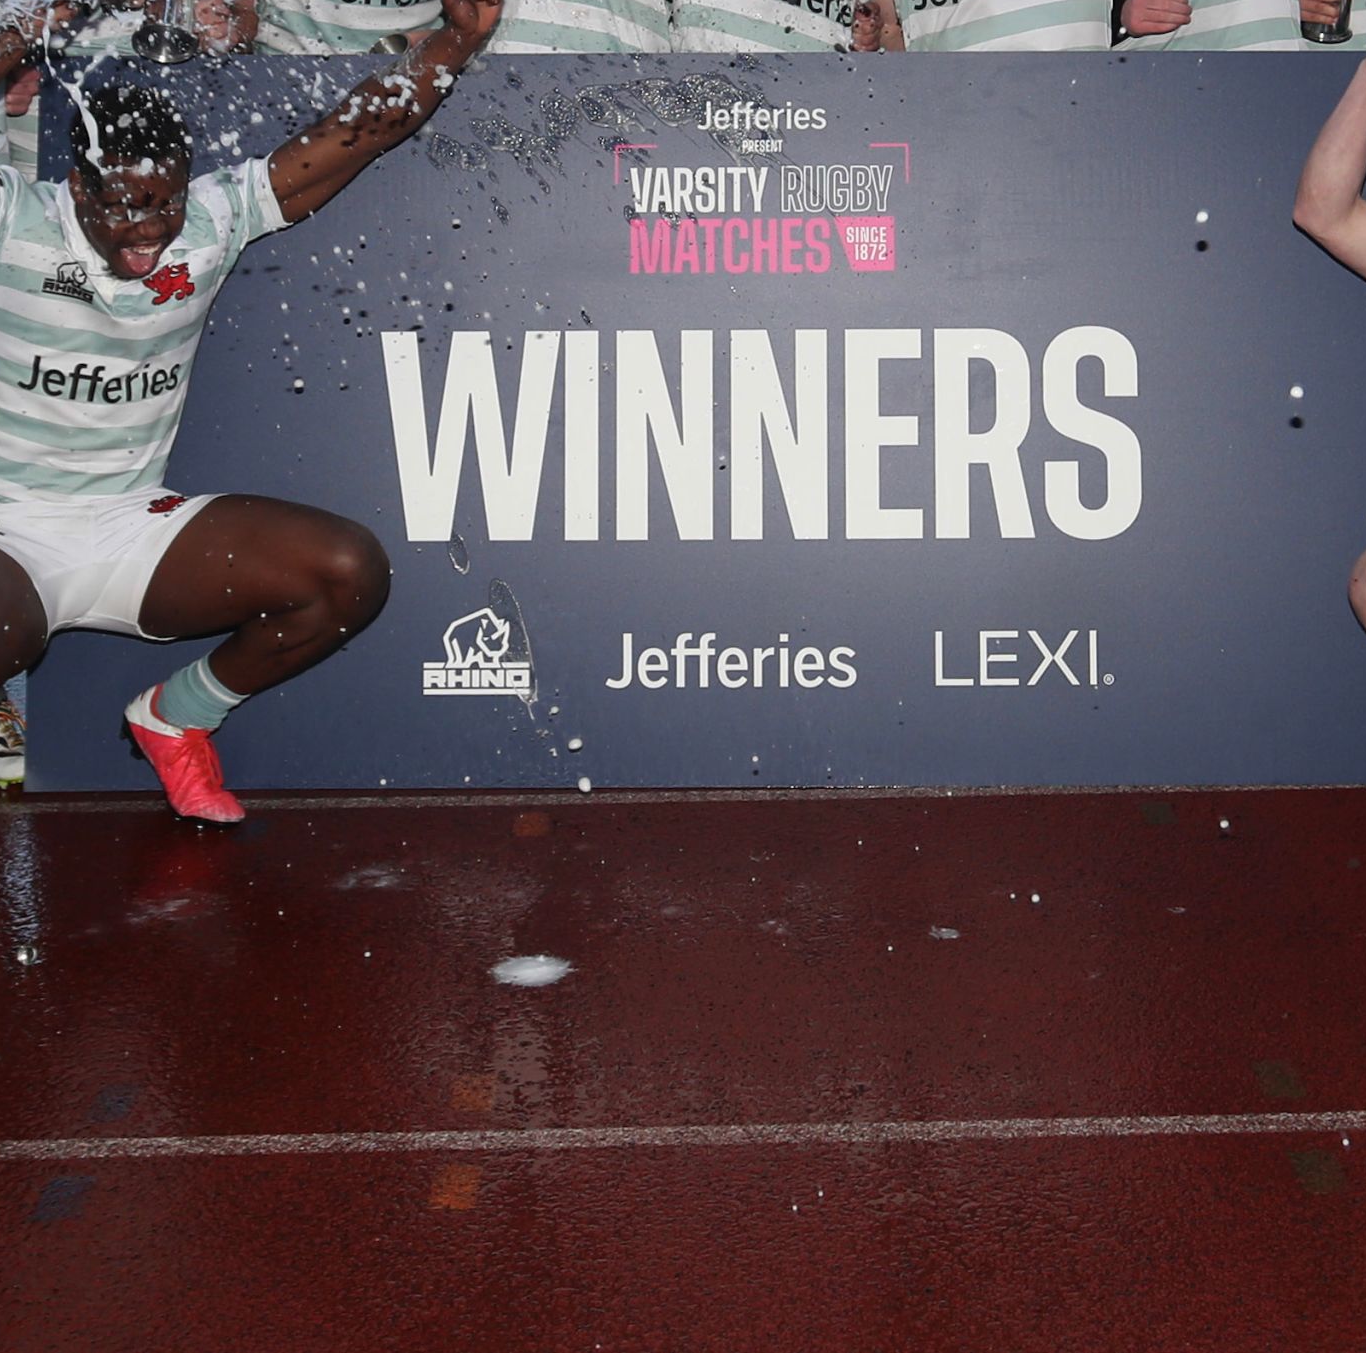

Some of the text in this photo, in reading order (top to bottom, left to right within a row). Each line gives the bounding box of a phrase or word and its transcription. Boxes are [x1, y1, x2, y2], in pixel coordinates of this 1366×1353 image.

[697, 101, 828, 131] Jefferies
[741, 139, 784, 153] PRESENT
[630, 165, 894, 214] VARSITY RUGBY
[629, 217, 832, 275] MATCHES
[845, 226, 888, 244] SINCE
[854, 244, 888, 261] 1872
[43, 280, 95, 303] RHINO
[17, 354, 181, 405] Jefferies
[380, 325, 1143, 541] WINNERS
[605, 632, 858, 690] Jefferies
[423, 669, 530, 689] RHINO
